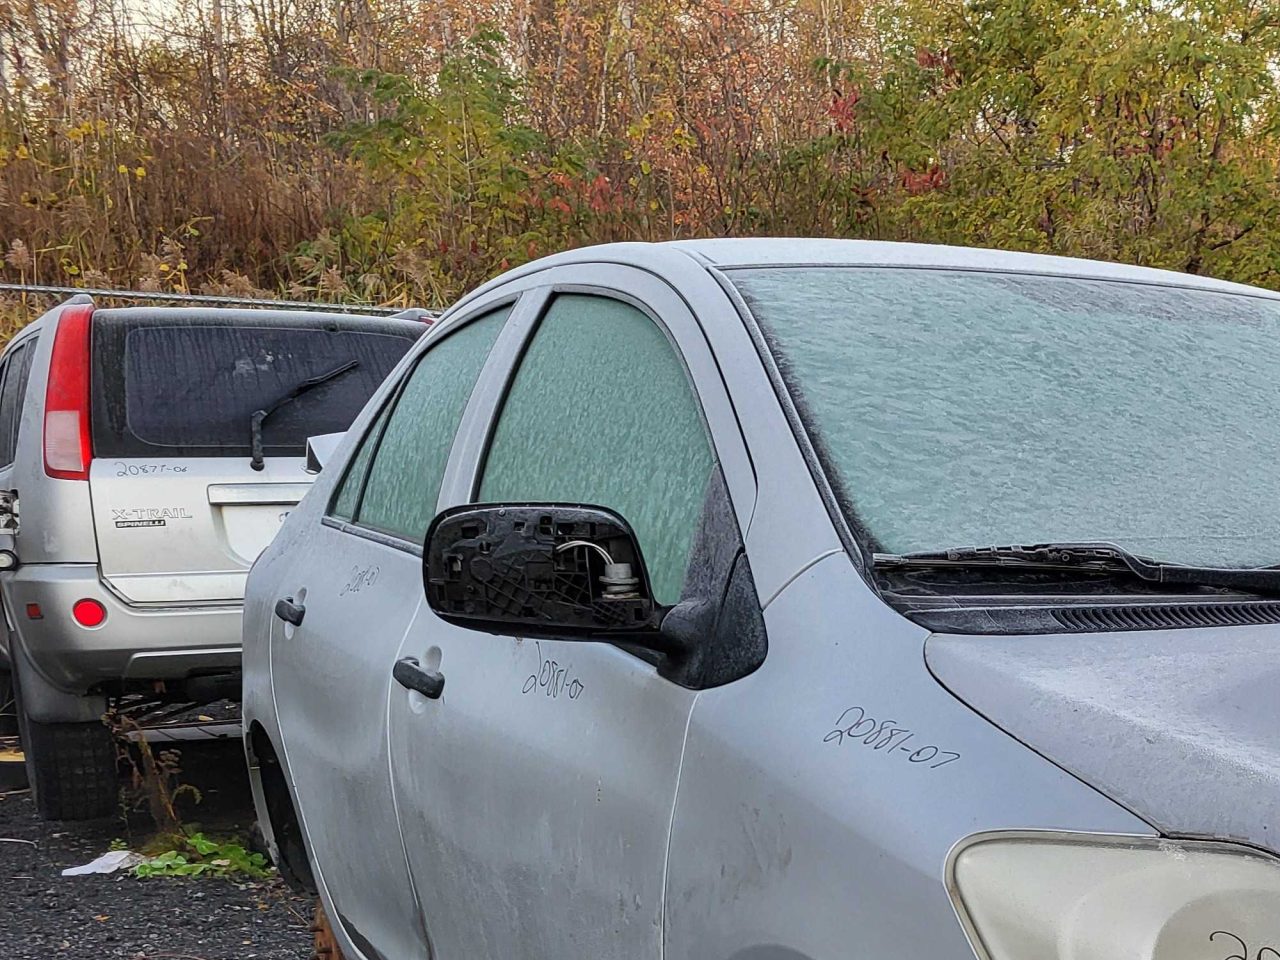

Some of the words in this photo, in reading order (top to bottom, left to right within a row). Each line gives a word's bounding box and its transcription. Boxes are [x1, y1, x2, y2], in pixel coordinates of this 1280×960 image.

[112, 507, 193, 520] X-TRAIL
[116, 520, 165, 528] SPINELLI
[522, 640, 584, 700] 20881-07
[823, 706, 961, 769] 20881-07
